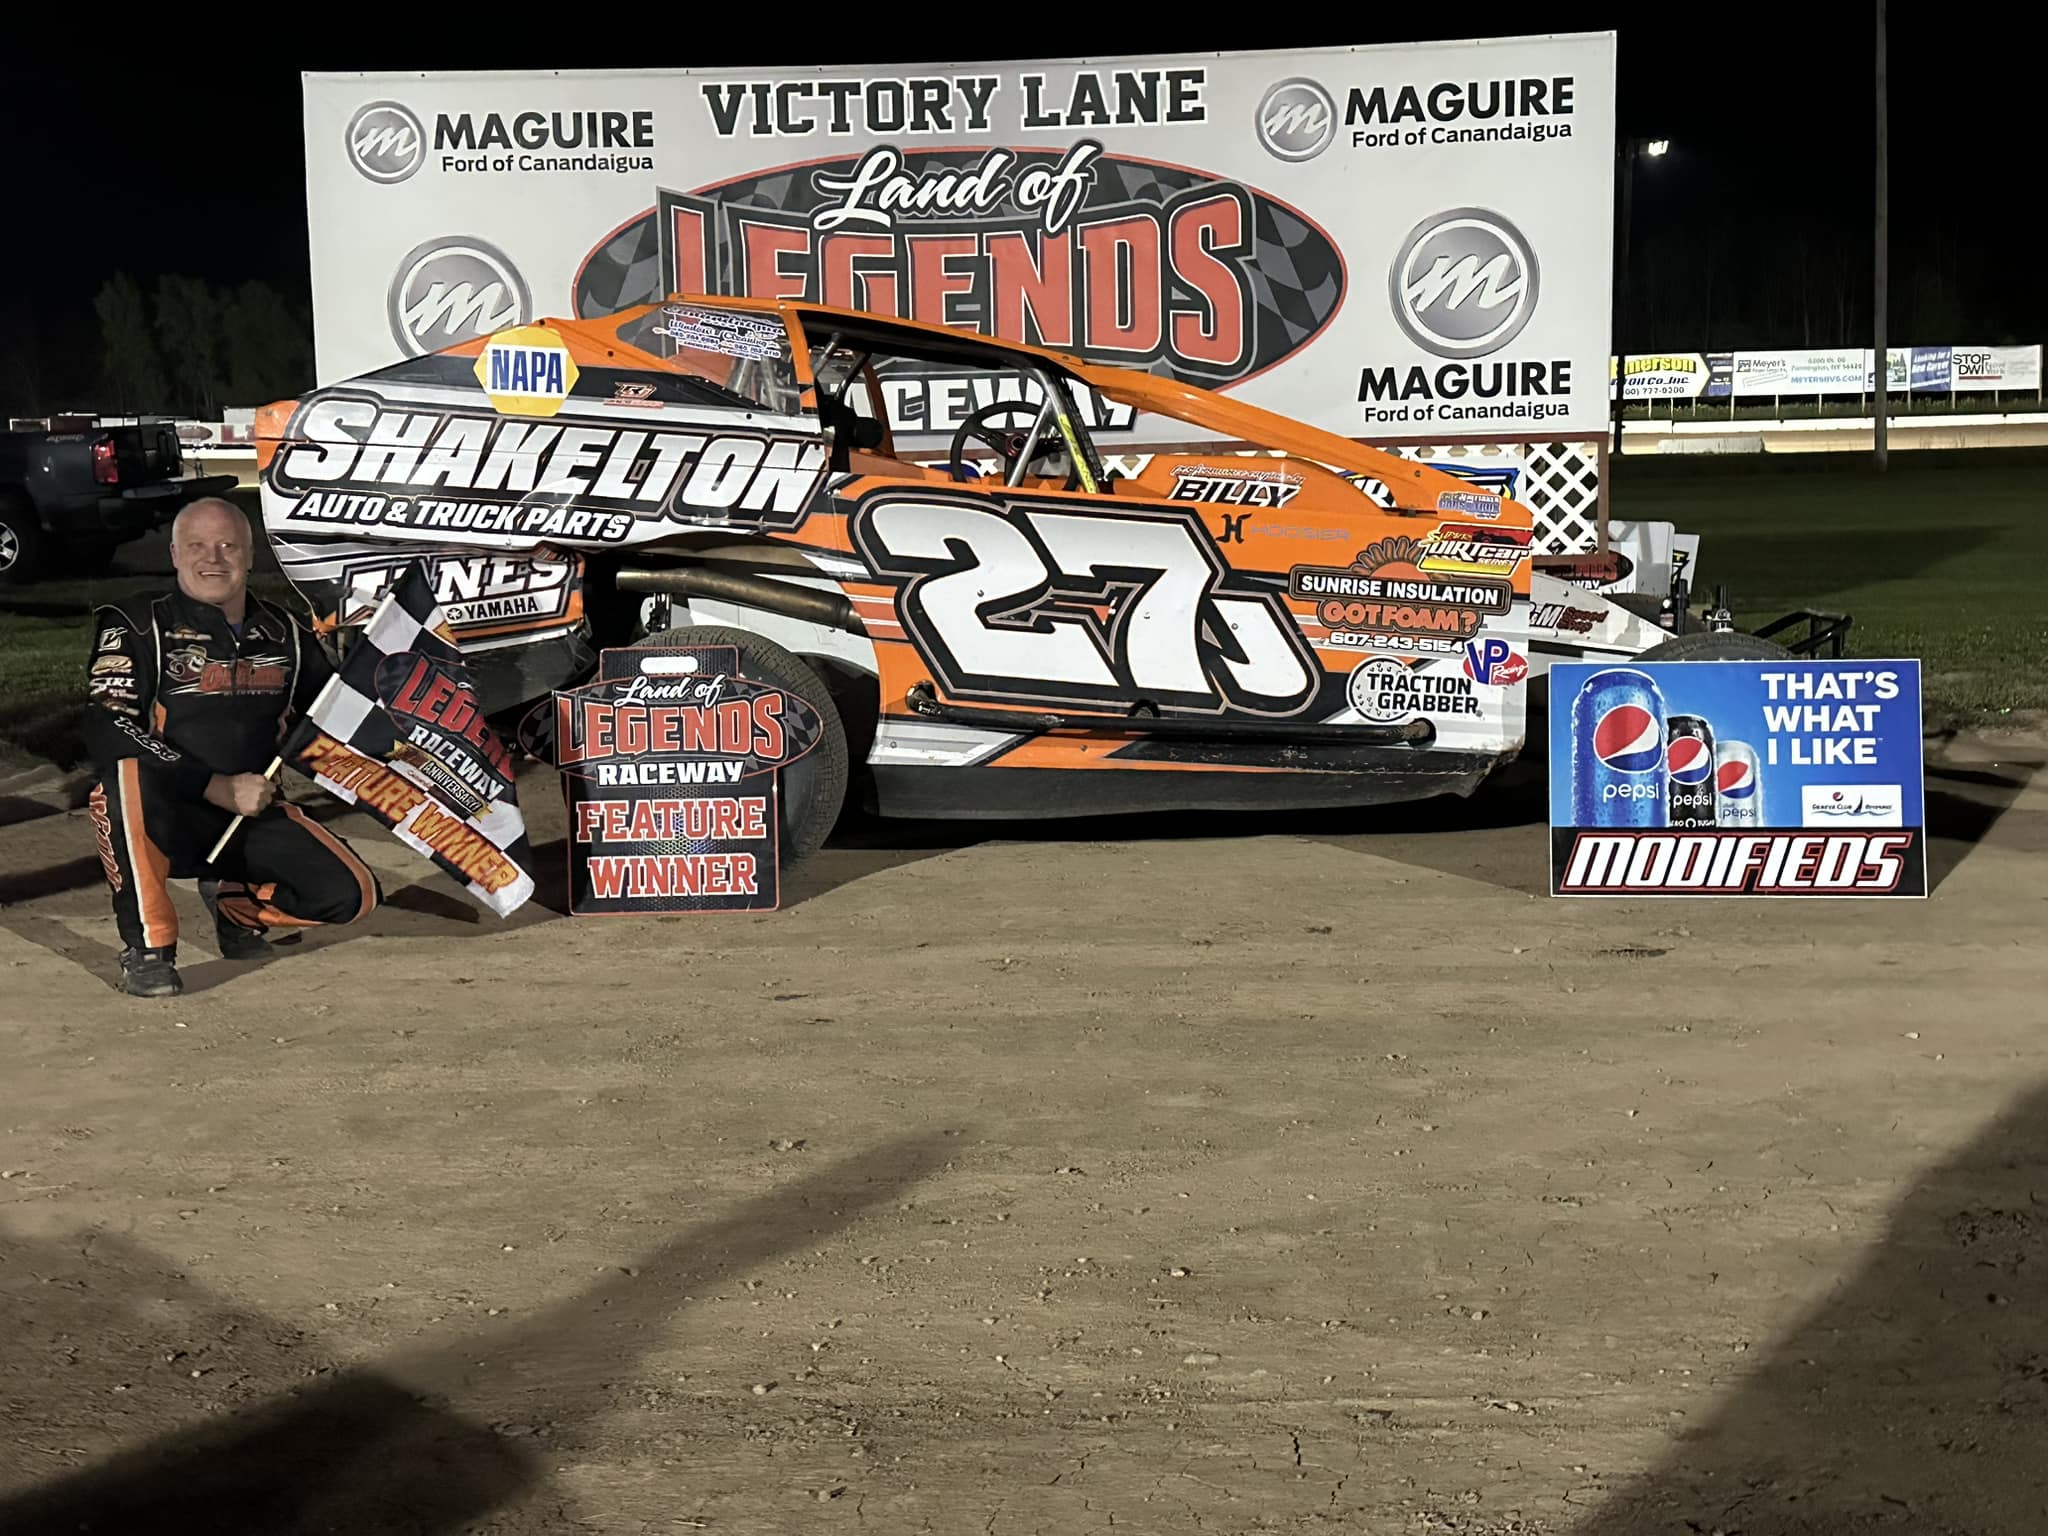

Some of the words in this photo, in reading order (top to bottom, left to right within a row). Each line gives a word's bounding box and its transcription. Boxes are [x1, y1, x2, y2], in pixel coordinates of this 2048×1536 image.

[701, 76, 1000, 136] VICTORY
[1022, 69, 1207, 128] LANE
[1345, 77, 1574, 125] MAGUIRE
[435, 111, 653, 150] MAGUIRE
[1352, 130, 1397, 148] Ford
[1402, 128, 1427, 146] of
[1431, 123, 1572, 147] Canandaigua
[442, 156, 487, 173] Ford
[492, 155, 514, 172] of
[518, 153, 653, 177] Canandaigua
[815, 148, 1014, 229] Land
[1020, 144, 1098, 231] of
[670, 194, 1246, 368] LEGENDS
[491, 347, 565, 395] NAPA
[1613, 357, 1697, 377] merson
[1952, 353, 1991, 364] STOP
[1958, 364, 1984, 375] DWI
[1358, 361, 1572, 403] MAGUIRE
[1365, 406, 1407, 423] Ford
[1412, 404, 1434, 421] of
[1437, 401, 1570, 425] Canandaigua
[284, 400, 827, 514] SHAKELTON
[1169, 476, 1301, 508] BILLY
[298, 492, 385, 520] AUTO
[390, 502, 407, 521] &
[412, 499, 528, 531] TRUCK
[523, 510, 633, 540] PARTS
[1251, 524, 1350, 542] HOOSIER
[1301, 574, 1382, 597] SUNRISE
[1386, 581, 1498, 605] INSULATION
[464, 596, 539, 620] YAMAHA
[1323, 600, 1381, 625] GOT
[1382, 604, 1477, 633] FOAM?
[1329, 631, 1464, 654] 607-243-5154
[1466, 639, 1510, 685] VP
[614, 675, 689, 707] Land
[693, 674, 725, 708] of
[1366, 672, 1472, 695] TRACTION
[1760, 671, 1899, 701] THAT'S
[1377, 692, 1478, 714] GRABBER
[1762, 704, 1881, 733] WHAT
[556, 693, 784, 766] LEGENDS
[407, 724, 504, 801] RACEWAY
[1767, 738, 1778, 766] I
[1790, 737, 1878, 766] LIKE
[597, 760, 746, 787] RACEWAY
[1603, 782, 1660, 803] pepsi
[1672, 792, 1713, 808] pepsi
[300, 732, 428, 824] FEATURE
[407, 800, 519, 895] WINNER
[576, 797, 767, 843] FEATURE
[1722, 806, 1757, 819] pepsi
[587, 852, 758, 899] WINNER
[1563, 834, 1909, 890] MODIFIEDS
